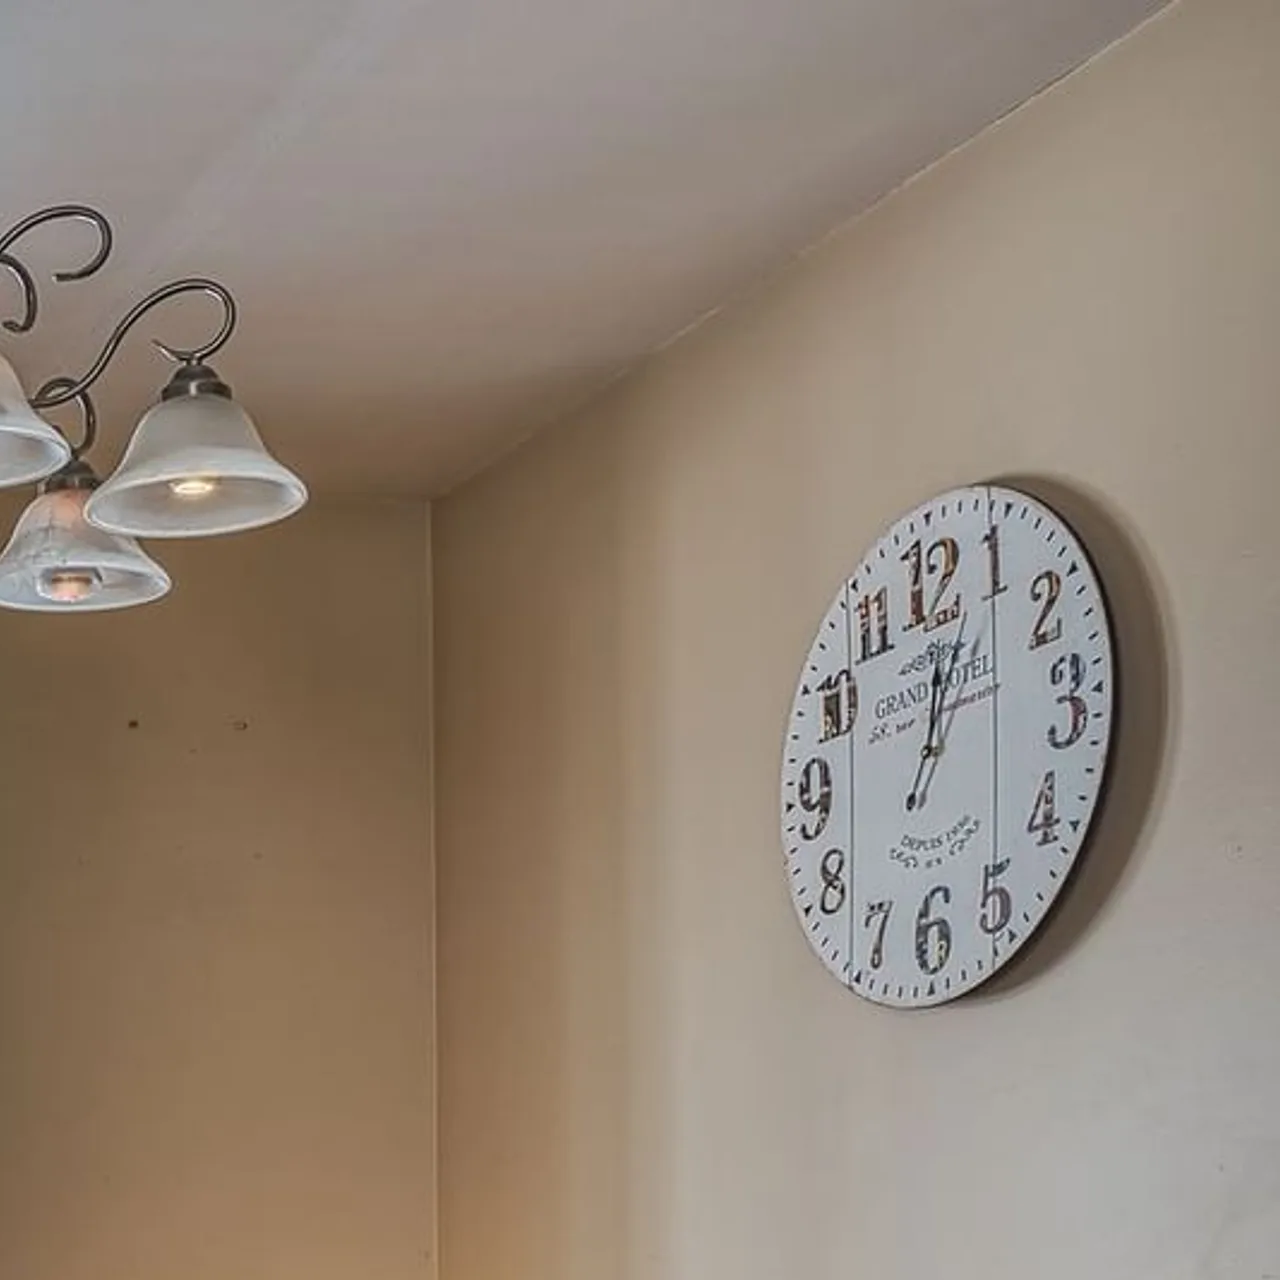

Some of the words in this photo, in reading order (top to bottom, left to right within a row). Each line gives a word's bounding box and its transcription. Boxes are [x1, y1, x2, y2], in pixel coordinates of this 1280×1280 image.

[901, 537, 960, 632] 12
[982, 525, 1008, 600] 1
[855, 587, 895, 665] 11
[1029, 570, 1062, 650] 2
[817, 670, 859, 744] 10
[875, 681, 929, 719] GRAND
[940, 654, 992, 692] OTEL
[1048, 652, 1088, 750] 3
[799, 757, 832, 840] 9
[1027, 770, 1061, 845] 4
[820, 849, 845, 914] 8
[980, 857, 1011, 934] 5
[865, 901, 893, 969] 7
[915, 886, 951, 975] 6
